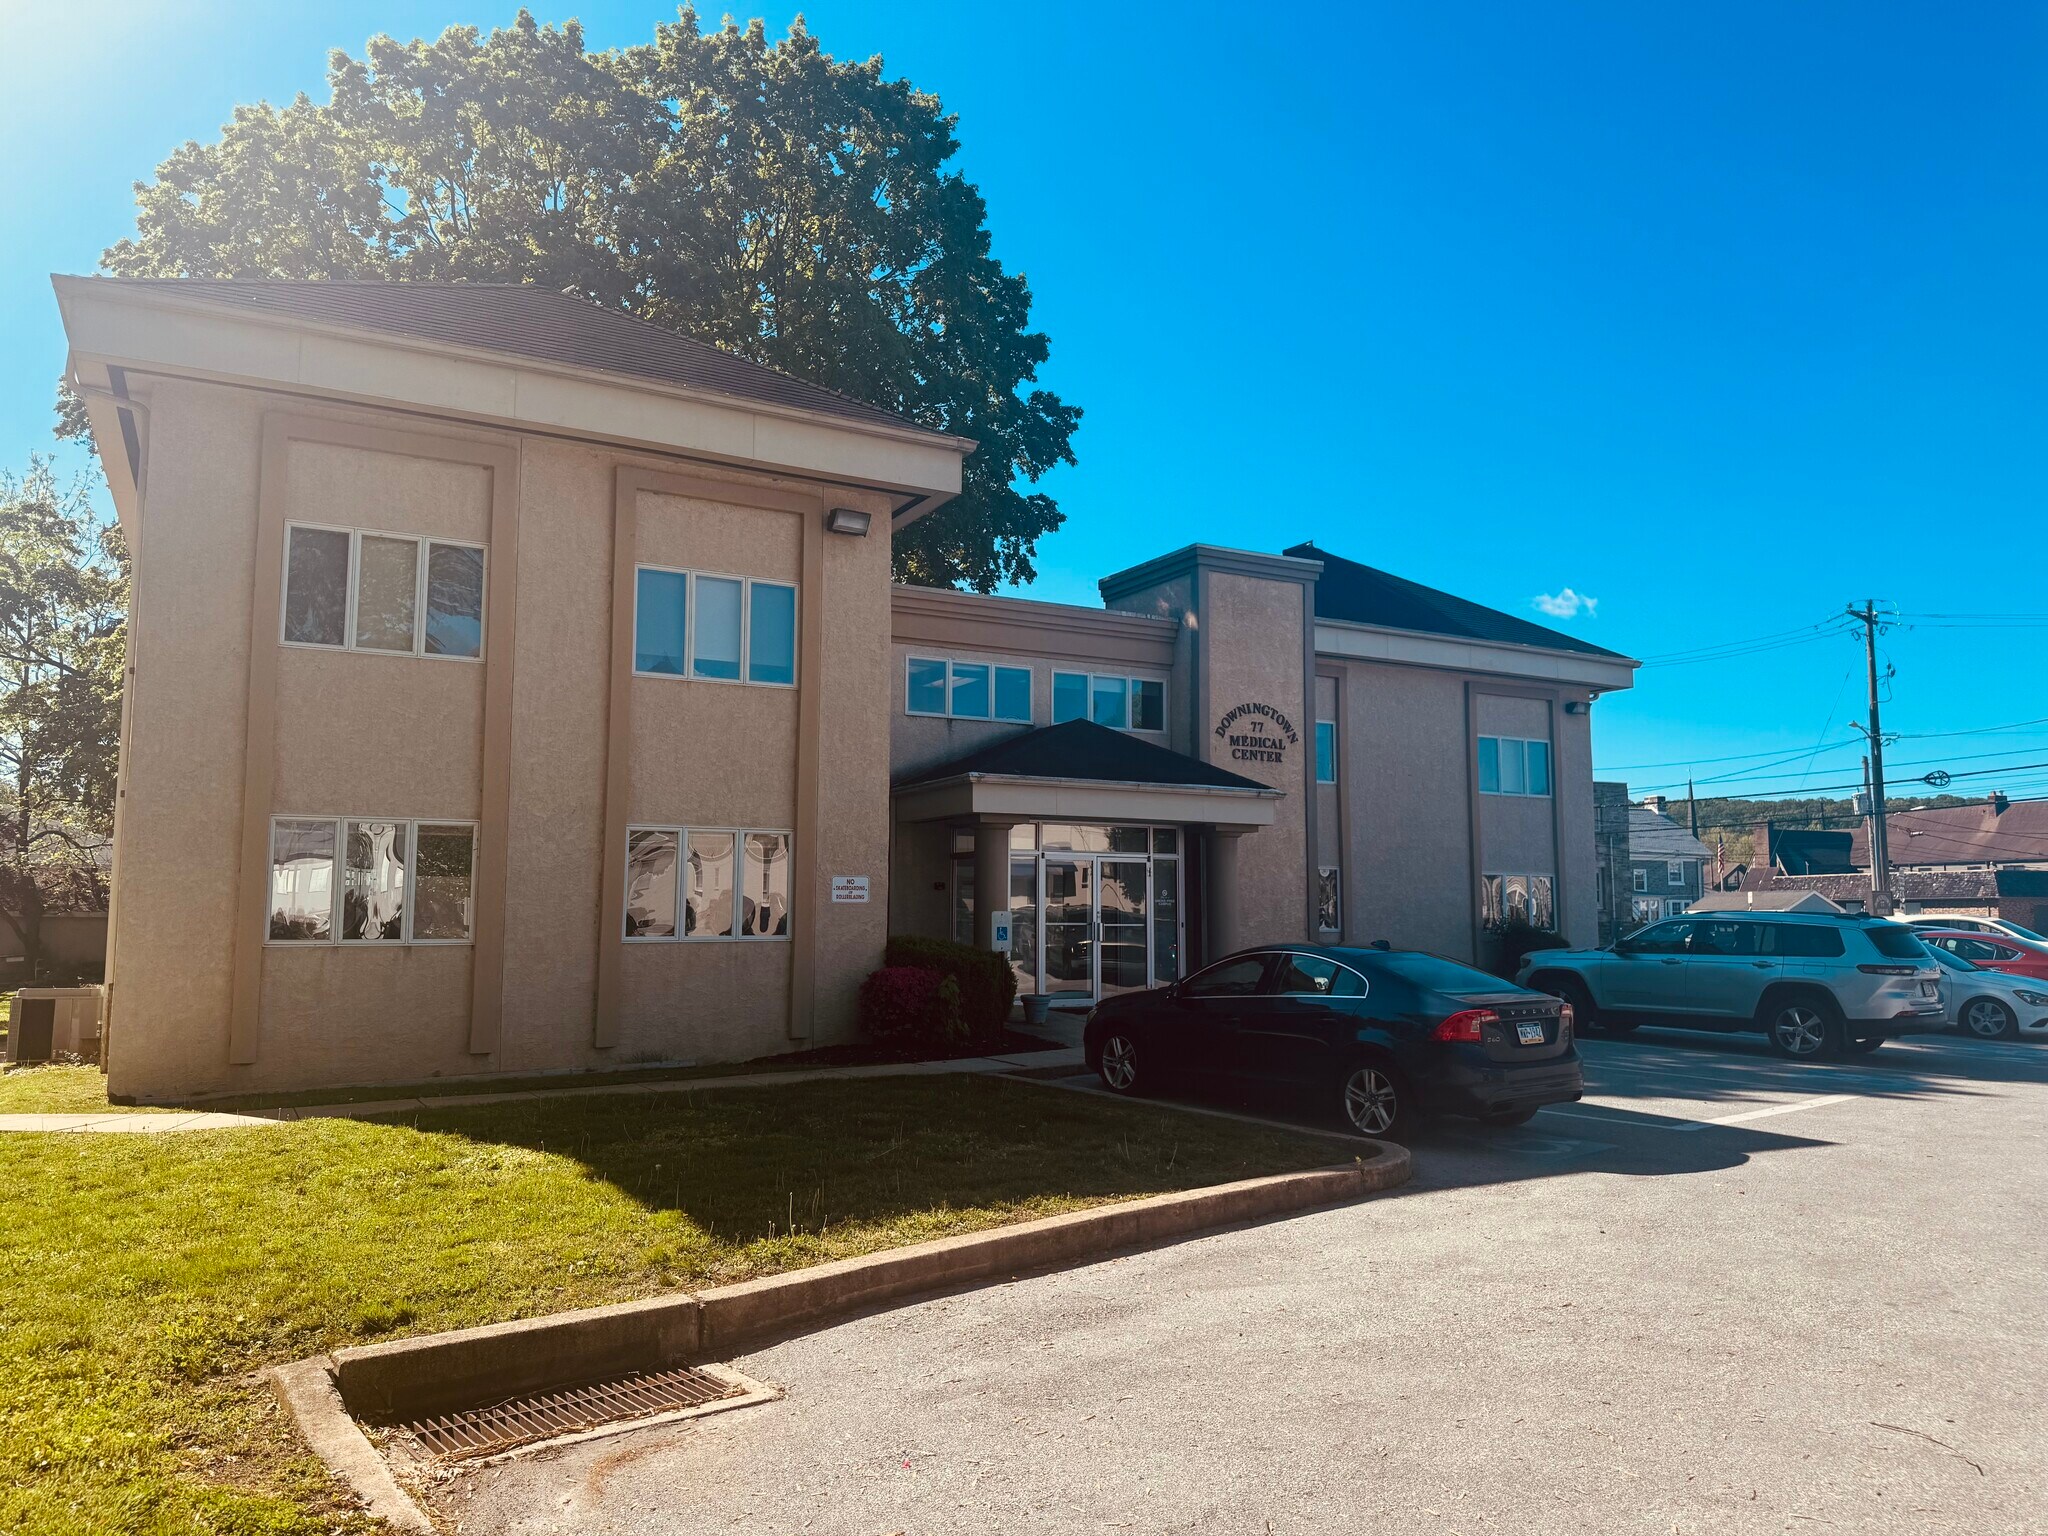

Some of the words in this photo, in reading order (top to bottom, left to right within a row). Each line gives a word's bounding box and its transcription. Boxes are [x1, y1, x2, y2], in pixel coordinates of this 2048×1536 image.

[1215, 702, 1298, 744] DOWNINGTOWN
[1250, 721, 1264, 733] 77
[1229, 735, 1286, 750] MEDICAL
[1231, 748, 1283, 763] CENTER
